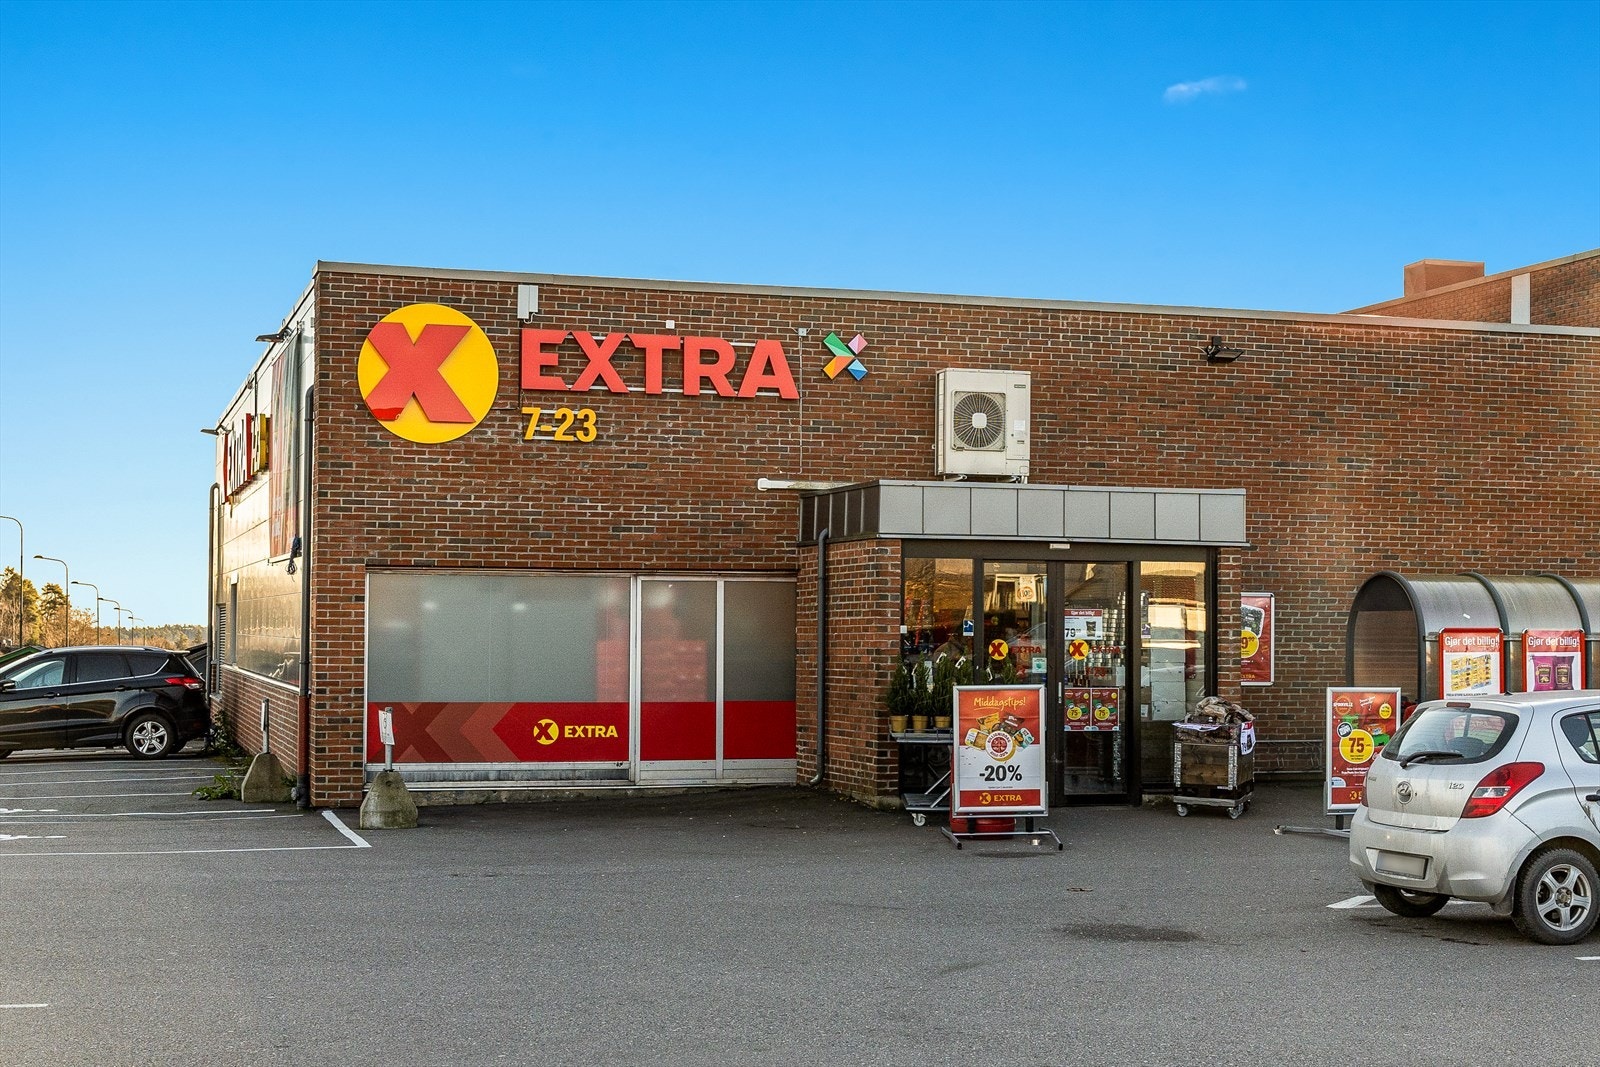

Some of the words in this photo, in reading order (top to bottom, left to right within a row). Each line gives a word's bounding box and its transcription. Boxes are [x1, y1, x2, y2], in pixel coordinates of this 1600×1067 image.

[520, 327, 800, 400] EXTRA
[521, 407, 598, 443] 7-23
[1445, 636, 1462, 647] Gjør
[1463, 636, 1476, 646] det
[1477, 636, 1499, 648] billig!
[1528, 636, 1544, 647] Gjør
[1546, 636, 1558, 646] det
[1560, 636, 1580, 648] billig!
[1011, 646, 1042, 655] EXTRA
[1091, 646, 1121, 654] EXTRA
[974, 696, 1026, 711] Middagstips!
[564, 725, 618, 737] EXTRA
[1349, 737, 1364, 754] 75
[979, 764, 1022, 782] -20%
[994, 794, 1022, 802] EXTRA
